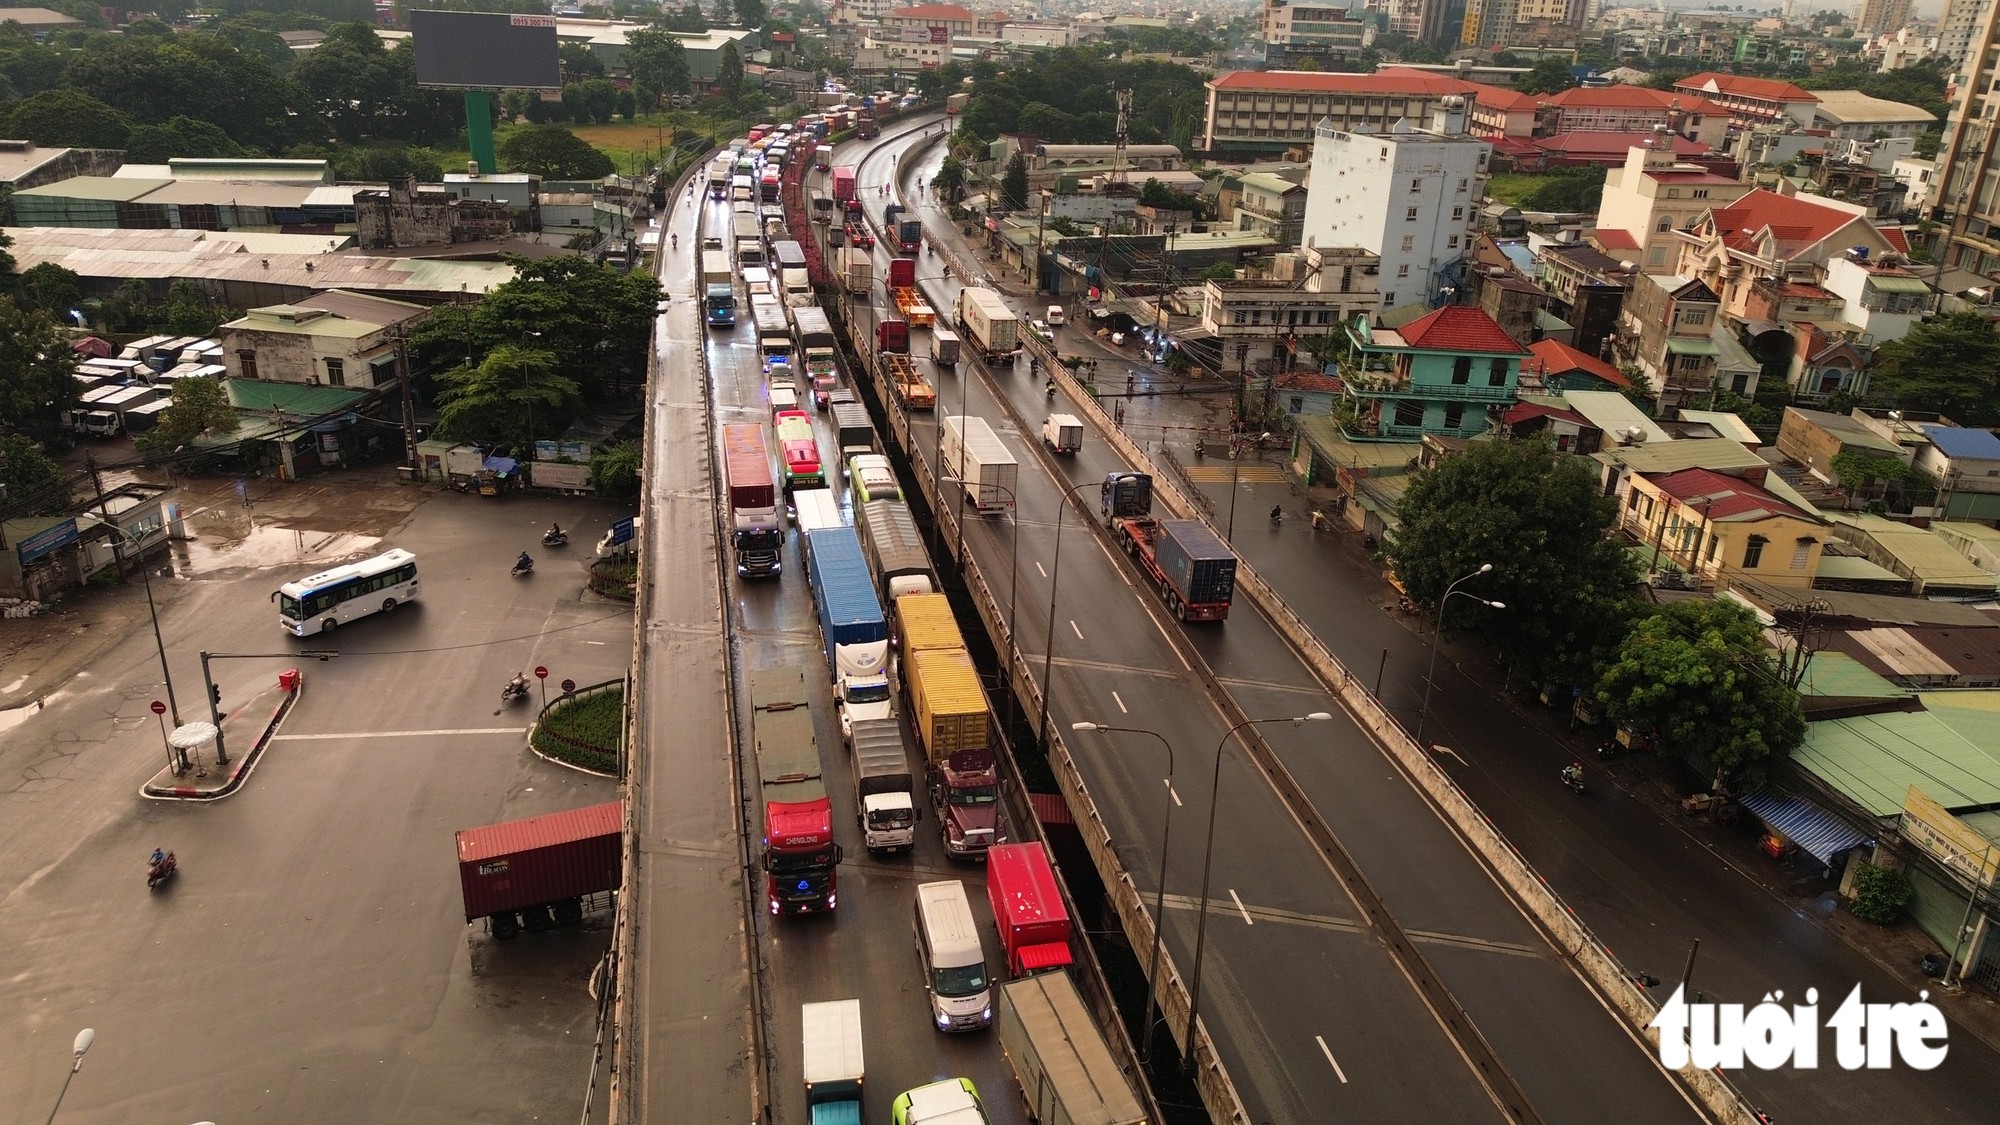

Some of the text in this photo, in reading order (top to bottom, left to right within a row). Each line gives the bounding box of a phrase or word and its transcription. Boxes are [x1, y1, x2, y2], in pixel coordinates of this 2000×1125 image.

[513, 18, 528, 26] 0919
[785, 835, 818, 845] CHENGLONG
[483, 864, 509, 875] BEACON
